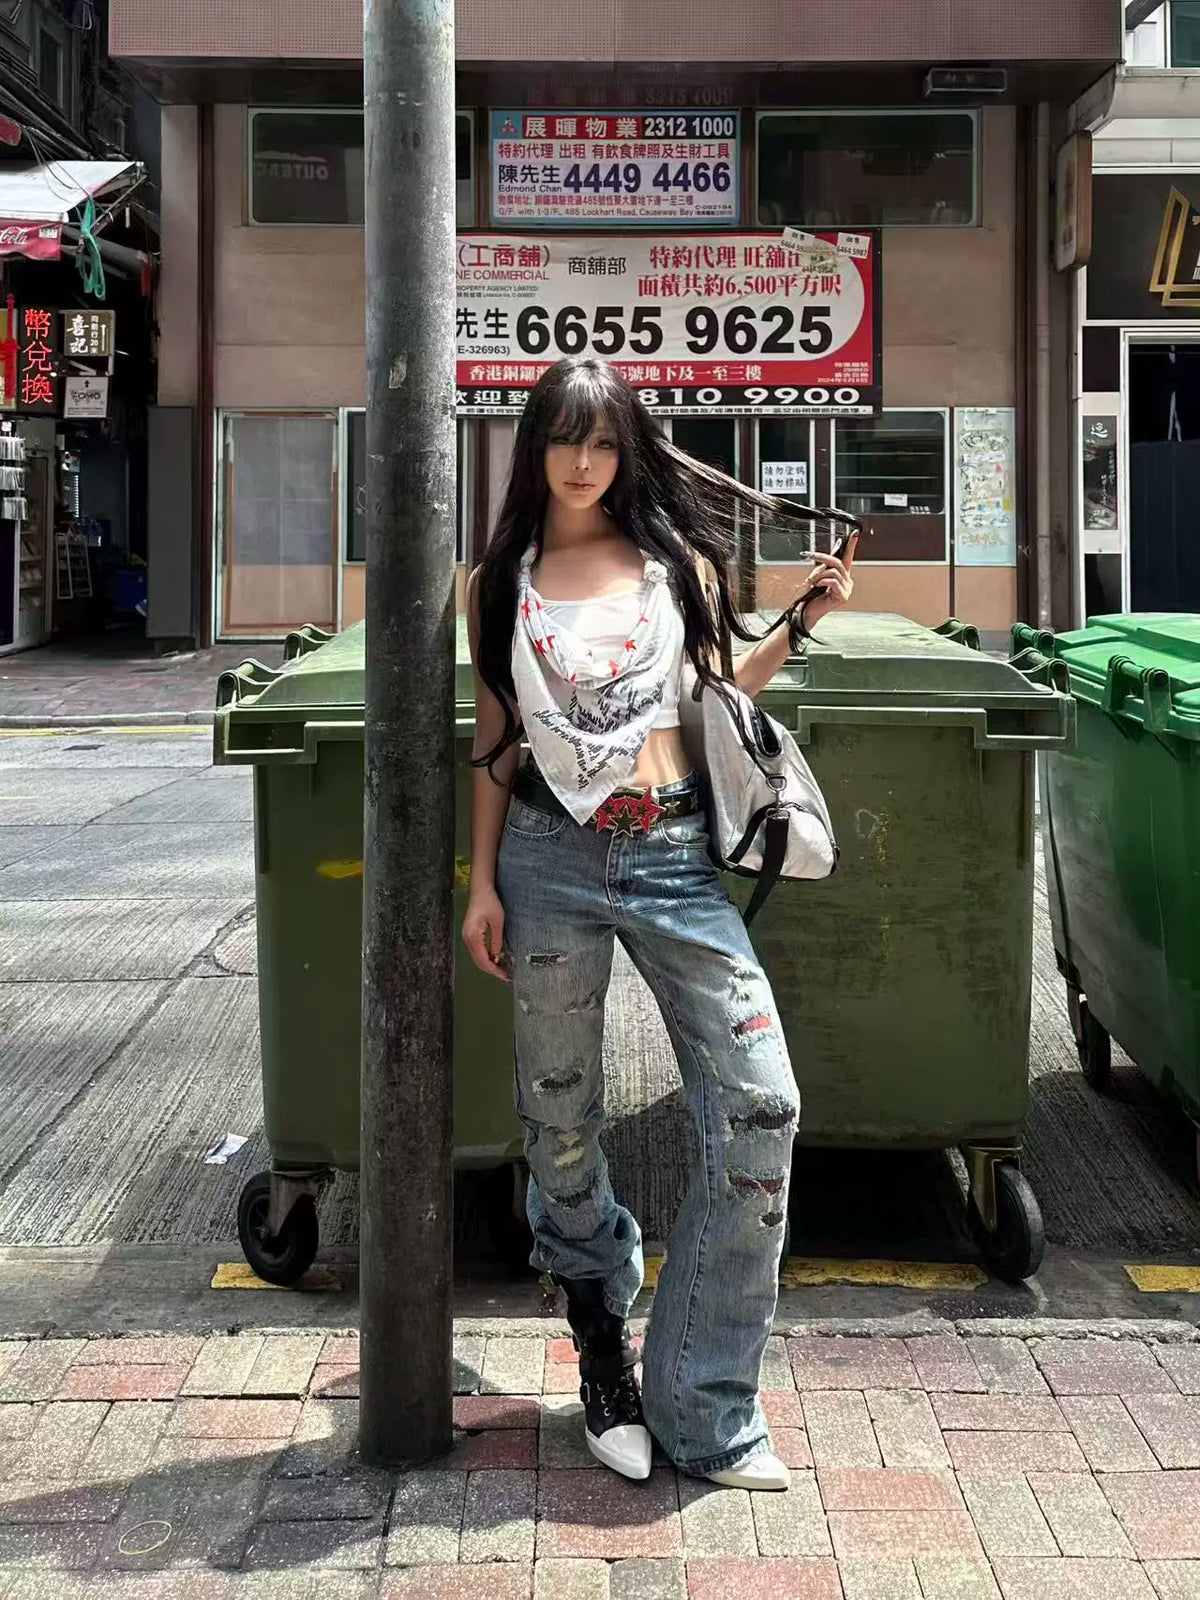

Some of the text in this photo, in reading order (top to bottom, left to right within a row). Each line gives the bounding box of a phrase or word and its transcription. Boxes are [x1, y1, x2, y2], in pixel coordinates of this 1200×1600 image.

[525, 117, 637, 138] 展暉物業
[645, 117, 686, 137] 2312
[692, 117, 733, 137] 1000
[499, 142, 731, 159] 特約代理 出租 有飲食牌照及生財工具
[498, 162, 731, 193] 陳先生 4449 4466
[499, 184, 562, 193] Edmond Chan
[518, 207, 534, 216] with
[582, 207, 615, 216] Lockhart
[639, 207, 677, 217] Causeway
[679, 207, 693, 217] Bay
[459, 245, 550, 267] (工商舖)
[568, 256, 626, 275] 商舖部
[650, 245, 737, 268] 特約代理
[473, 270, 549, 281] COMMERCIAL
[638, 273, 841, 297] 面積共約6,500平方呎
[67, 313, 90, 353] 喜記
[456, 305, 833, 355] 先生 6655 9625
[458, 345, 510, 356] E-326963)
[616, 364, 762, 382] 5號地下及一至三樓
[744, 387, 860, 405] 9900
